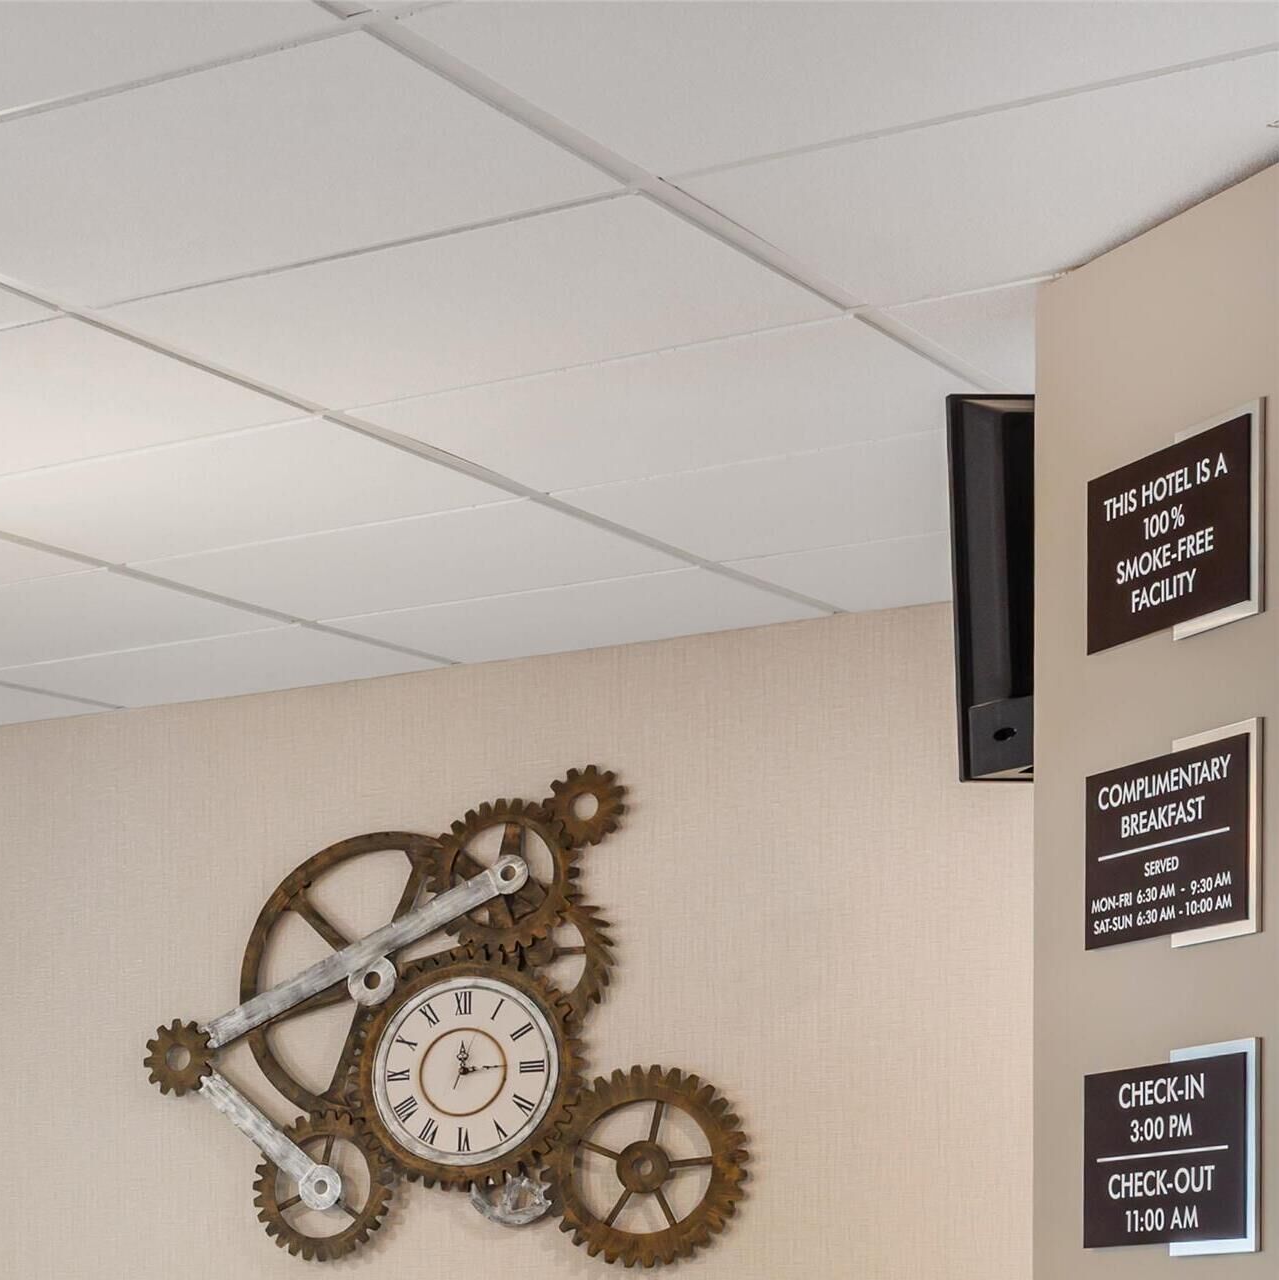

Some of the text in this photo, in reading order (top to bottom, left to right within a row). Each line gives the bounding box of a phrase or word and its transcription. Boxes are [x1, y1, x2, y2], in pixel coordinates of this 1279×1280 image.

[1104, 452, 1228, 522] THIS HOTEL IS A
[1143, 504, 1184, 540] 100%
[1116, 527, 1214, 585] SMOKE-FREE
[1131, 568, 1197, 613] FACILITY
[1098, 754, 1231, 810] COMPLIMENTARY
[1121, 796, 1205, 838] BREAKFAST
[1144, 856, 1179, 877] SERVED
[1091, 892, 1132, 914] MON-FRI
[1136, 886, 1158, 905] 6:30
[1159, 883, 1175, 900] AM
[1191, 877, 1213, 895] 9:30
[1214, 871, 1231, 890] AM
[1093, 914, 1132, 935] SAT-SUN
[1136, 908, 1158, 926] 6:30
[1159, 905, 1175, 922] AM
[1185, 899, 1213, 917] 10:00
[1215, 893, 1232, 911] AM
[419, 1004, 440, 1027] XI
[455, 992, 472, 1016] XII
[491, 999, 504, 1020] I
[396, 1035, 418, 1050] X
[510, 1022, 534, 1041] II
[387, 1069, 410, 1081] IX
[520, 1060, 544, 1073] III
[1118, 1073, 1204, 1109] CHECK-IN
[394, 1096, 418, 1122] VIII
[513, 1094, 535, 1116] IV
[418, 1118, 438, 1145] VII
[458, 1127, 470, 1151] VI
[493, 1119, 508, 1141] V
[1130, 1113, 1192, 1143] 3:00 PM
[1108, 1165, 1215, 1200] CHECK-OUT
[1125, 1205, 1198, 1233] 11:00 AM
